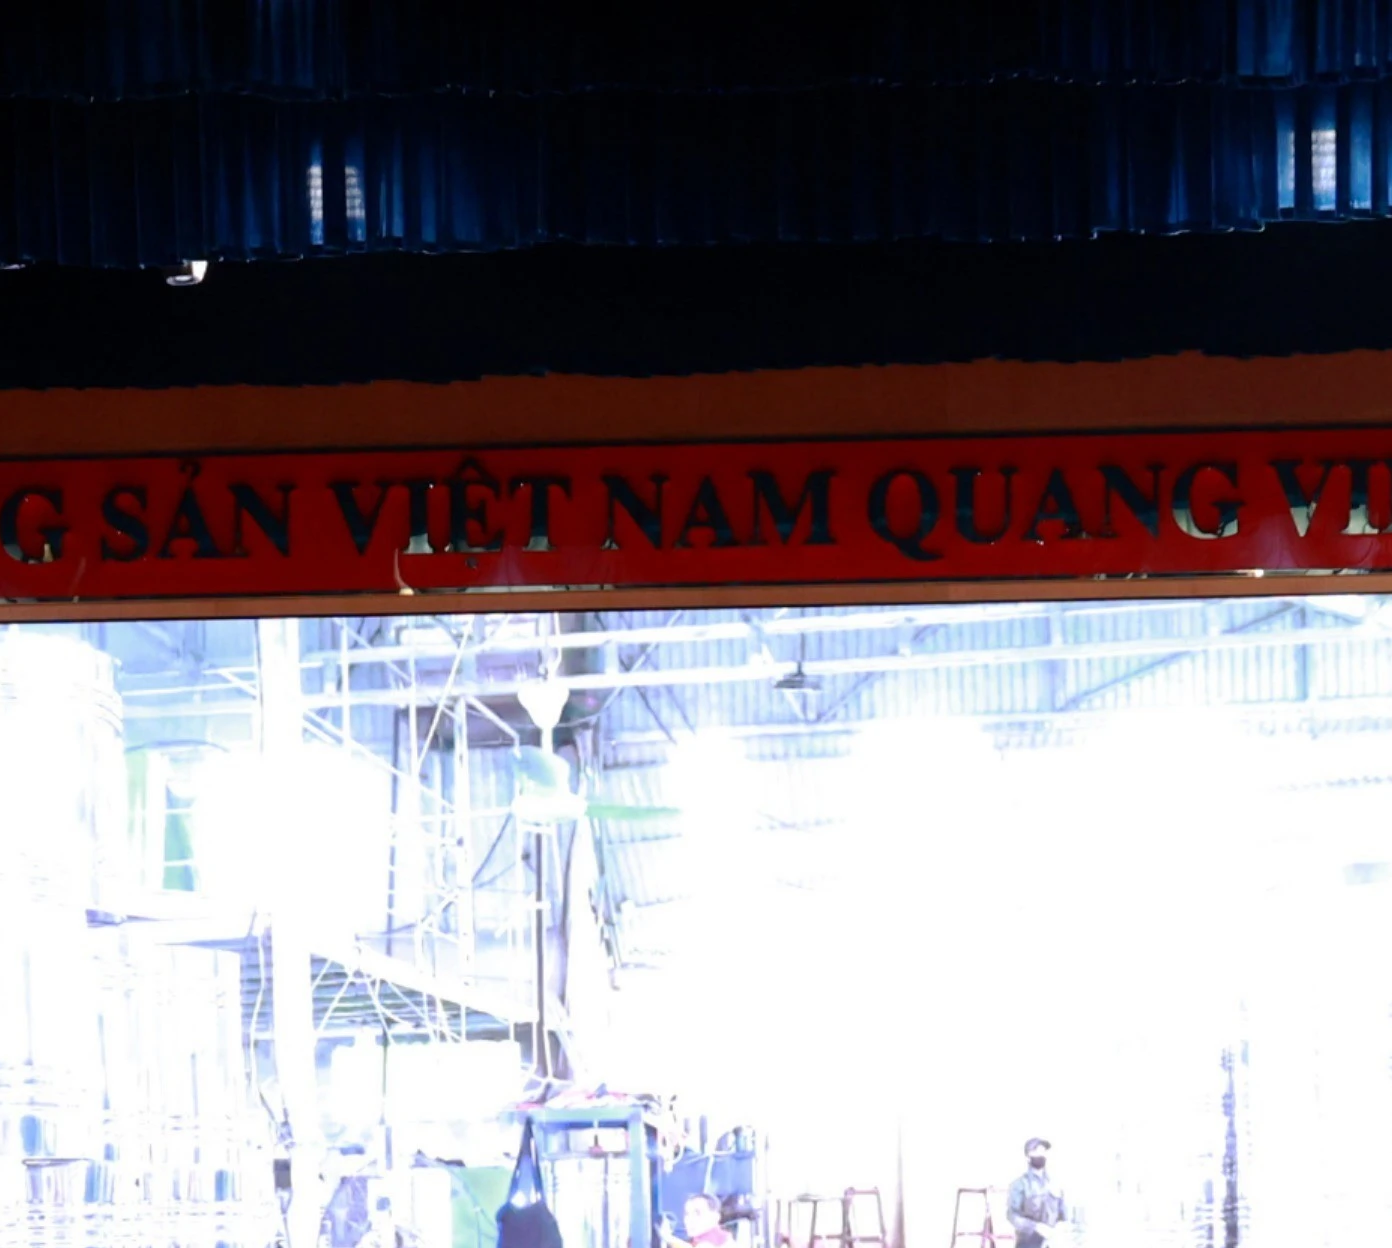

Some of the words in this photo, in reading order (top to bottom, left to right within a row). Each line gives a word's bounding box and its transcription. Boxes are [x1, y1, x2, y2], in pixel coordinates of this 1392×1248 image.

[100, 459, 298, 562] SẢN
[327, 456, 573, 570] VIỆT
[601, 467, 840, 551] NAM
[867, 461, 1247, 562] QUANG
